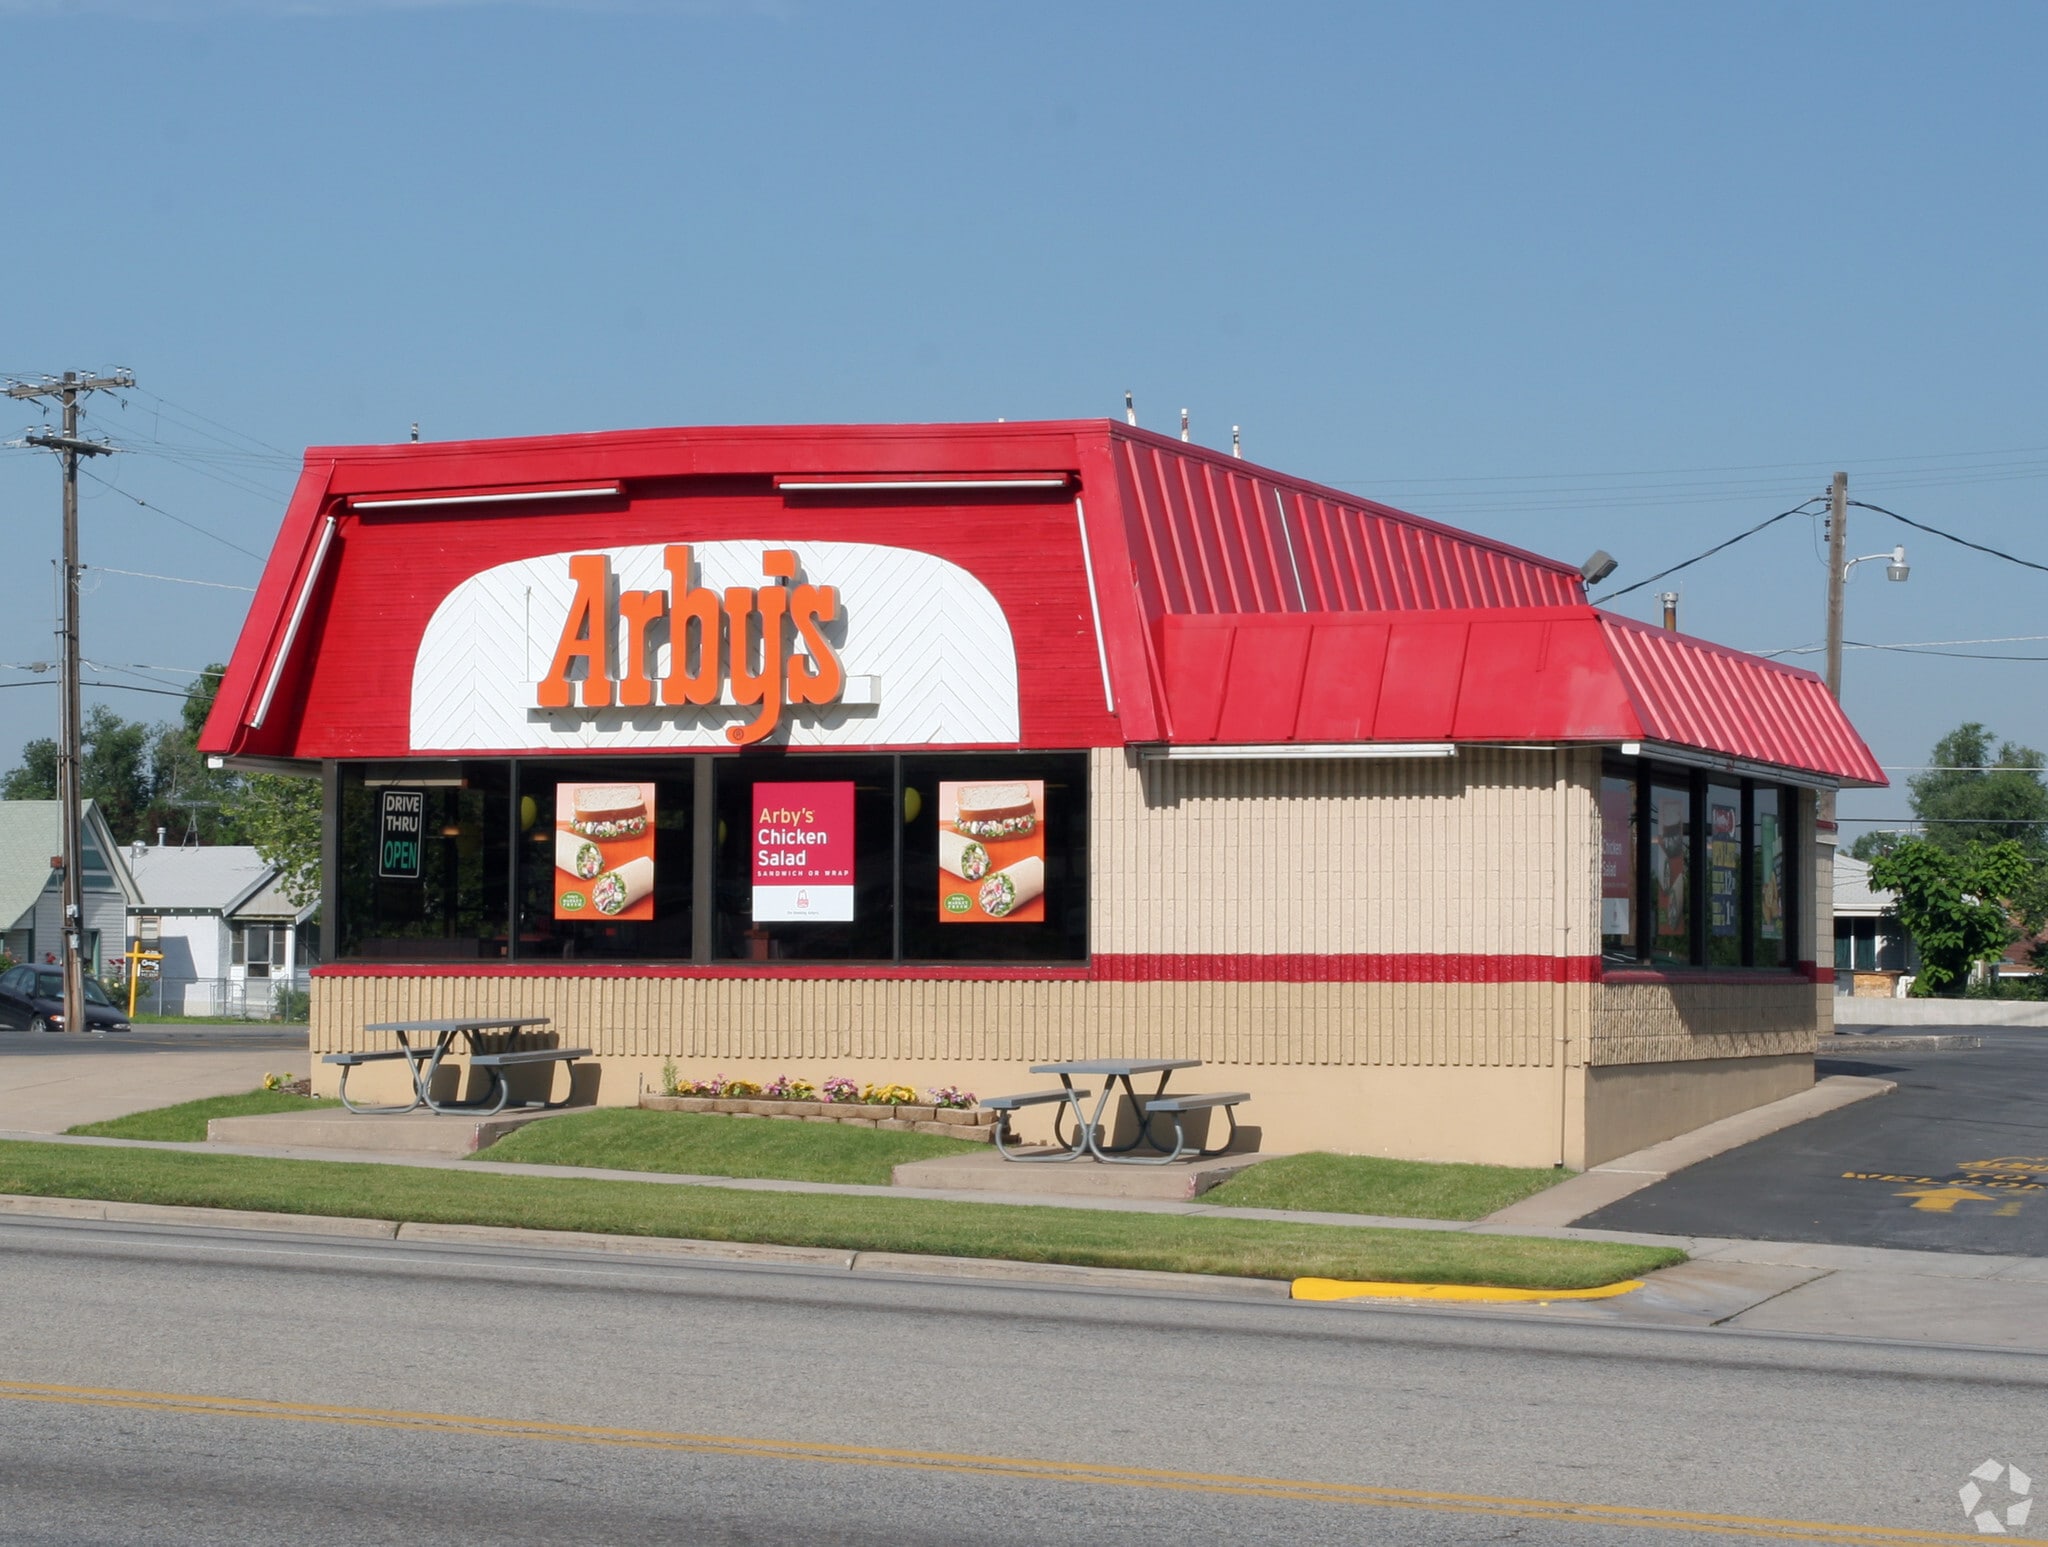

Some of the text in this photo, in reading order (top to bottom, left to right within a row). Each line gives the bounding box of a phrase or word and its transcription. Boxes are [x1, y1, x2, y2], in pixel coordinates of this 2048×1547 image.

[537, 545, 848, 745] Arby's
[386, 795, 420, 812] DRIVE
[386, 815, 418, 832] THRU
[759, 807, 814, 827] Arby's
[758, 828, 827, 845] Chicken
[384, 841, 417, 869] OPEN
[758, 850, 807, 866] Salad
